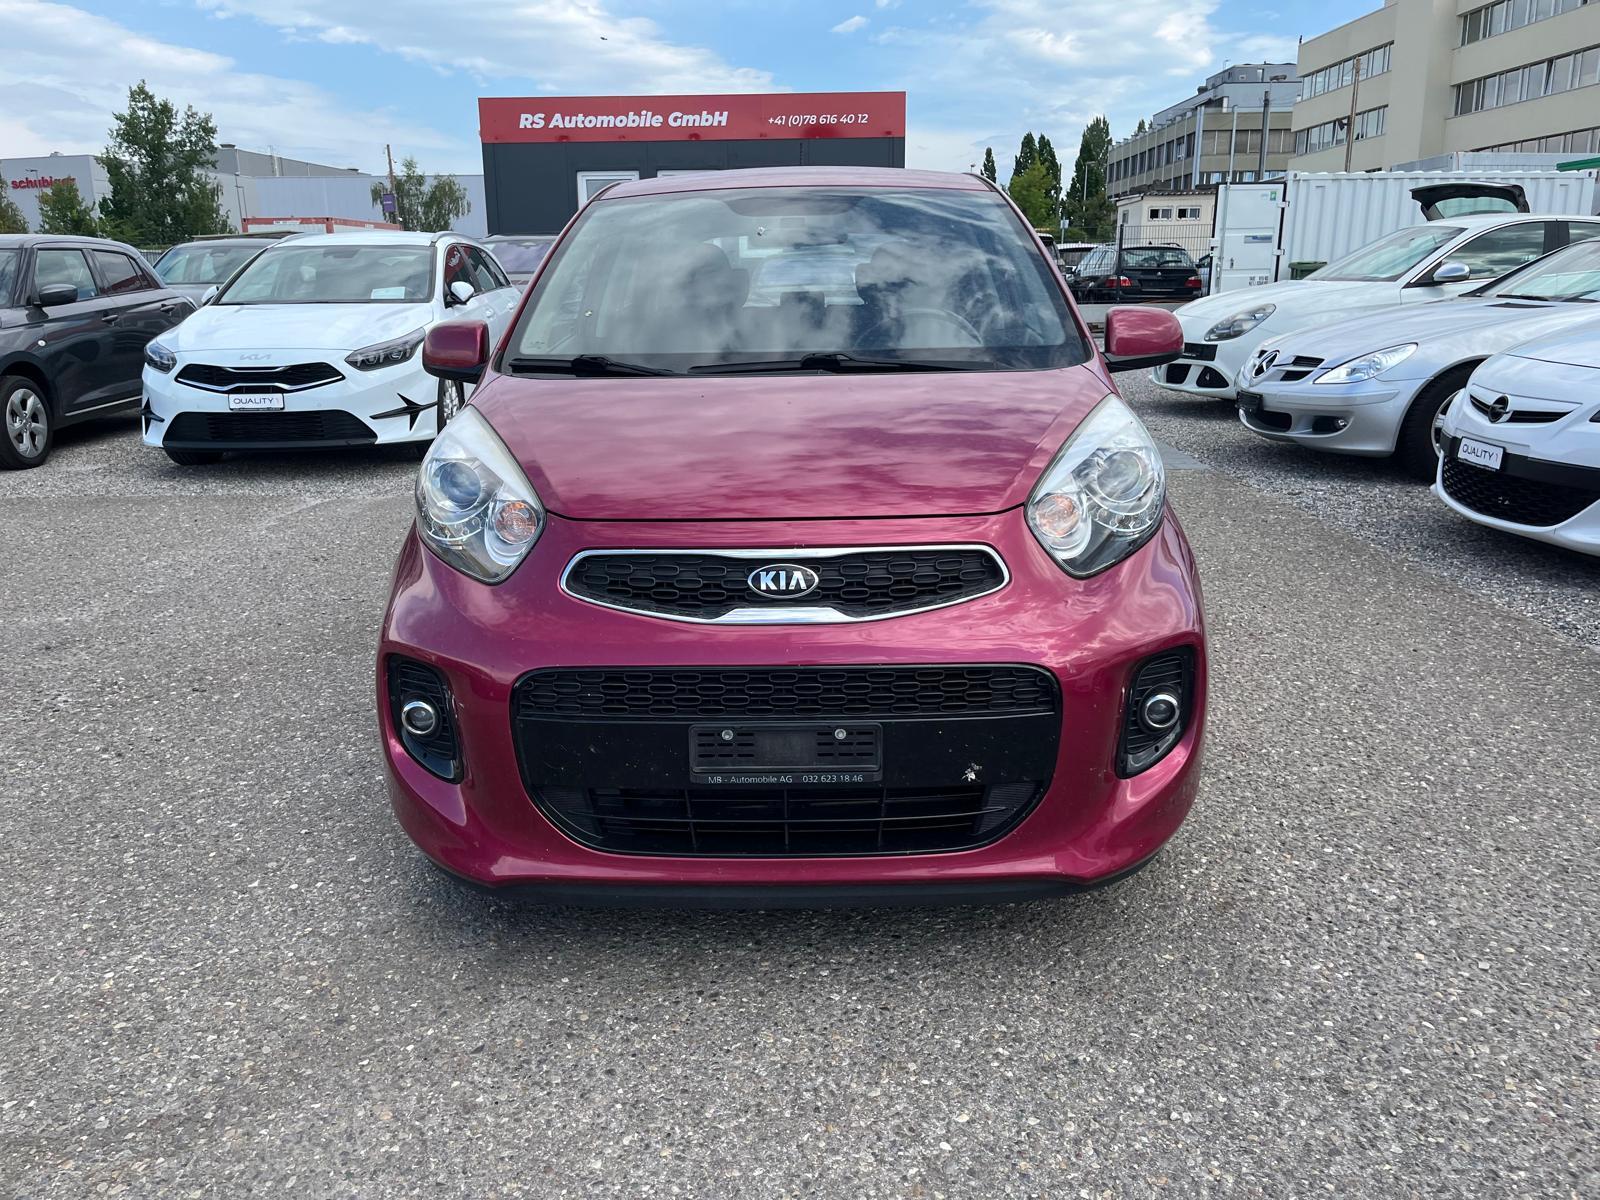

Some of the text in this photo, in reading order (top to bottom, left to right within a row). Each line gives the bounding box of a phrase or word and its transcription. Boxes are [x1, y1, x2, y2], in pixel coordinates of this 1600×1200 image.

[519, 110, 729, 129] RS Automobile GmbH
[768, 113, 869, 128] +41 (0)78 616 40 12
[11, 176, 76, 189] schubi
[233, 397, 273, 405] QUALITY
[1462, 443, 1494, 461] QUALITY
[759, 570, 808, 591] KIA
[730, 775, 778, 784] Automobile
[779, 775, 793, 784] AG
[802, 775, 819, 783] 032
[820, 774, 837, 783] 623
[840, 774, 850, 783] 18
[852, 774, 864, 783] 46
